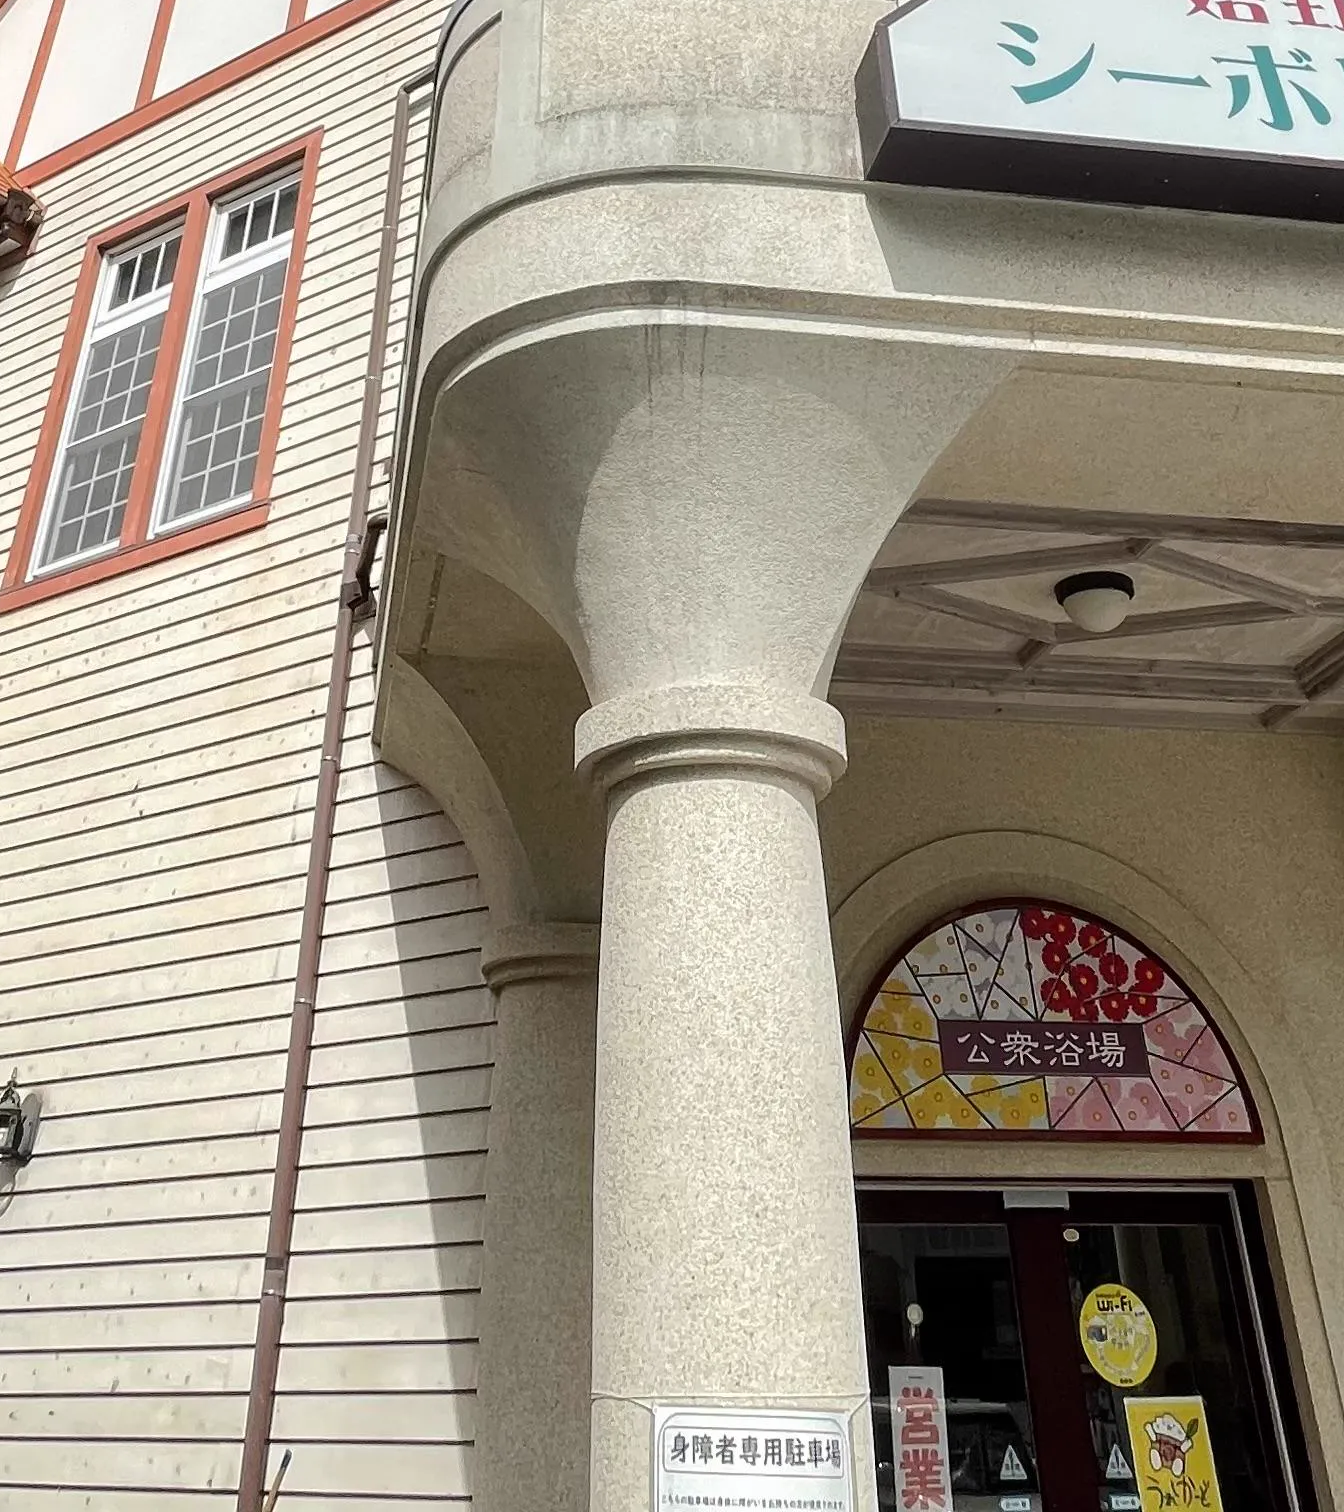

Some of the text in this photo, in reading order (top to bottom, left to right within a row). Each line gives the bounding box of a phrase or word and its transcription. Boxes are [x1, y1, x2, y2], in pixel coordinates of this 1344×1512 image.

[956, 1030, 1127, 1069] 公衆浴場
[669, 1431, 842, 1469] 身障者専用駐車場
